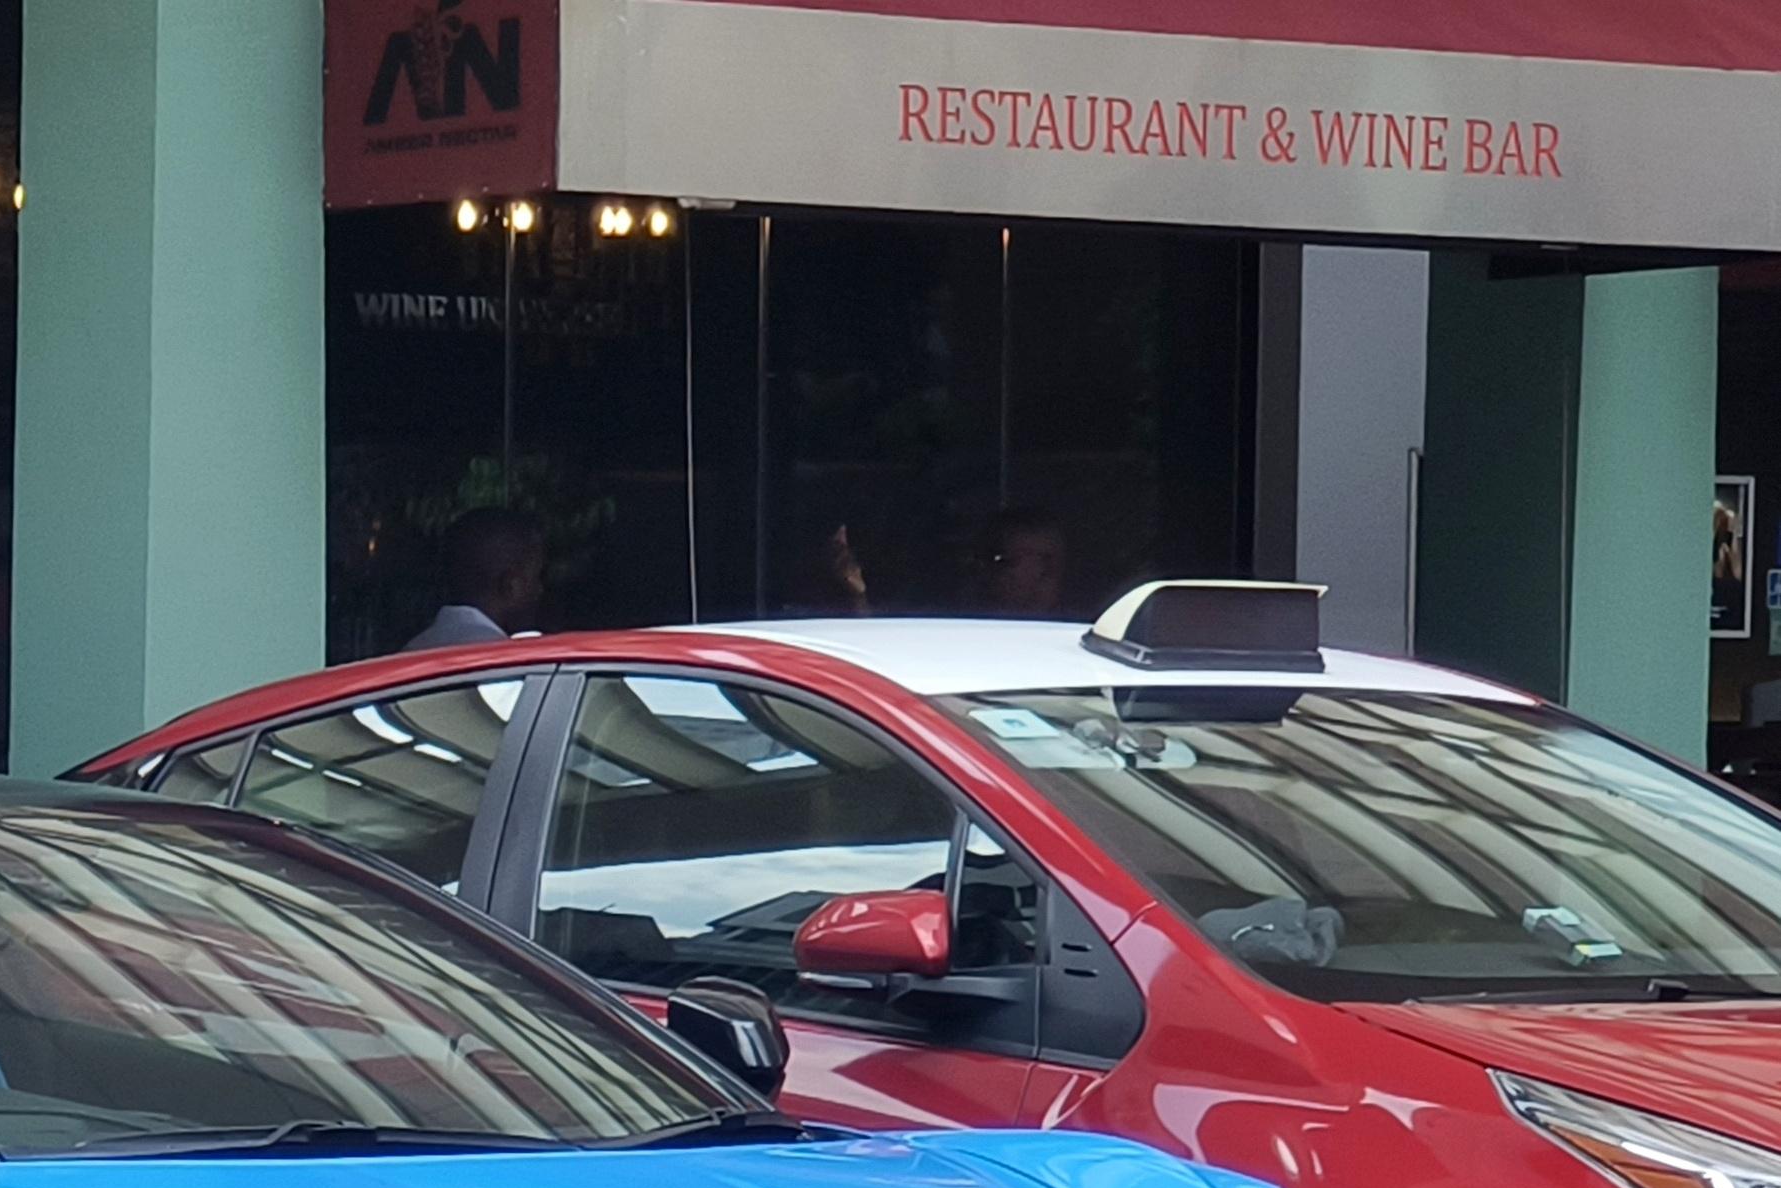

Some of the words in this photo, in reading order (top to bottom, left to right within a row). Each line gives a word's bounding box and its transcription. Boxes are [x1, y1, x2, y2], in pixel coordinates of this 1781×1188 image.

[896, 84, 1246, 160] RESTAURANT
[1261, 107, 1297, 164] &
[1311, 109, 1449, 172] WINE
[1462, 118, 1563, 178] BAR
[354, 292, 448, 332] WINE
